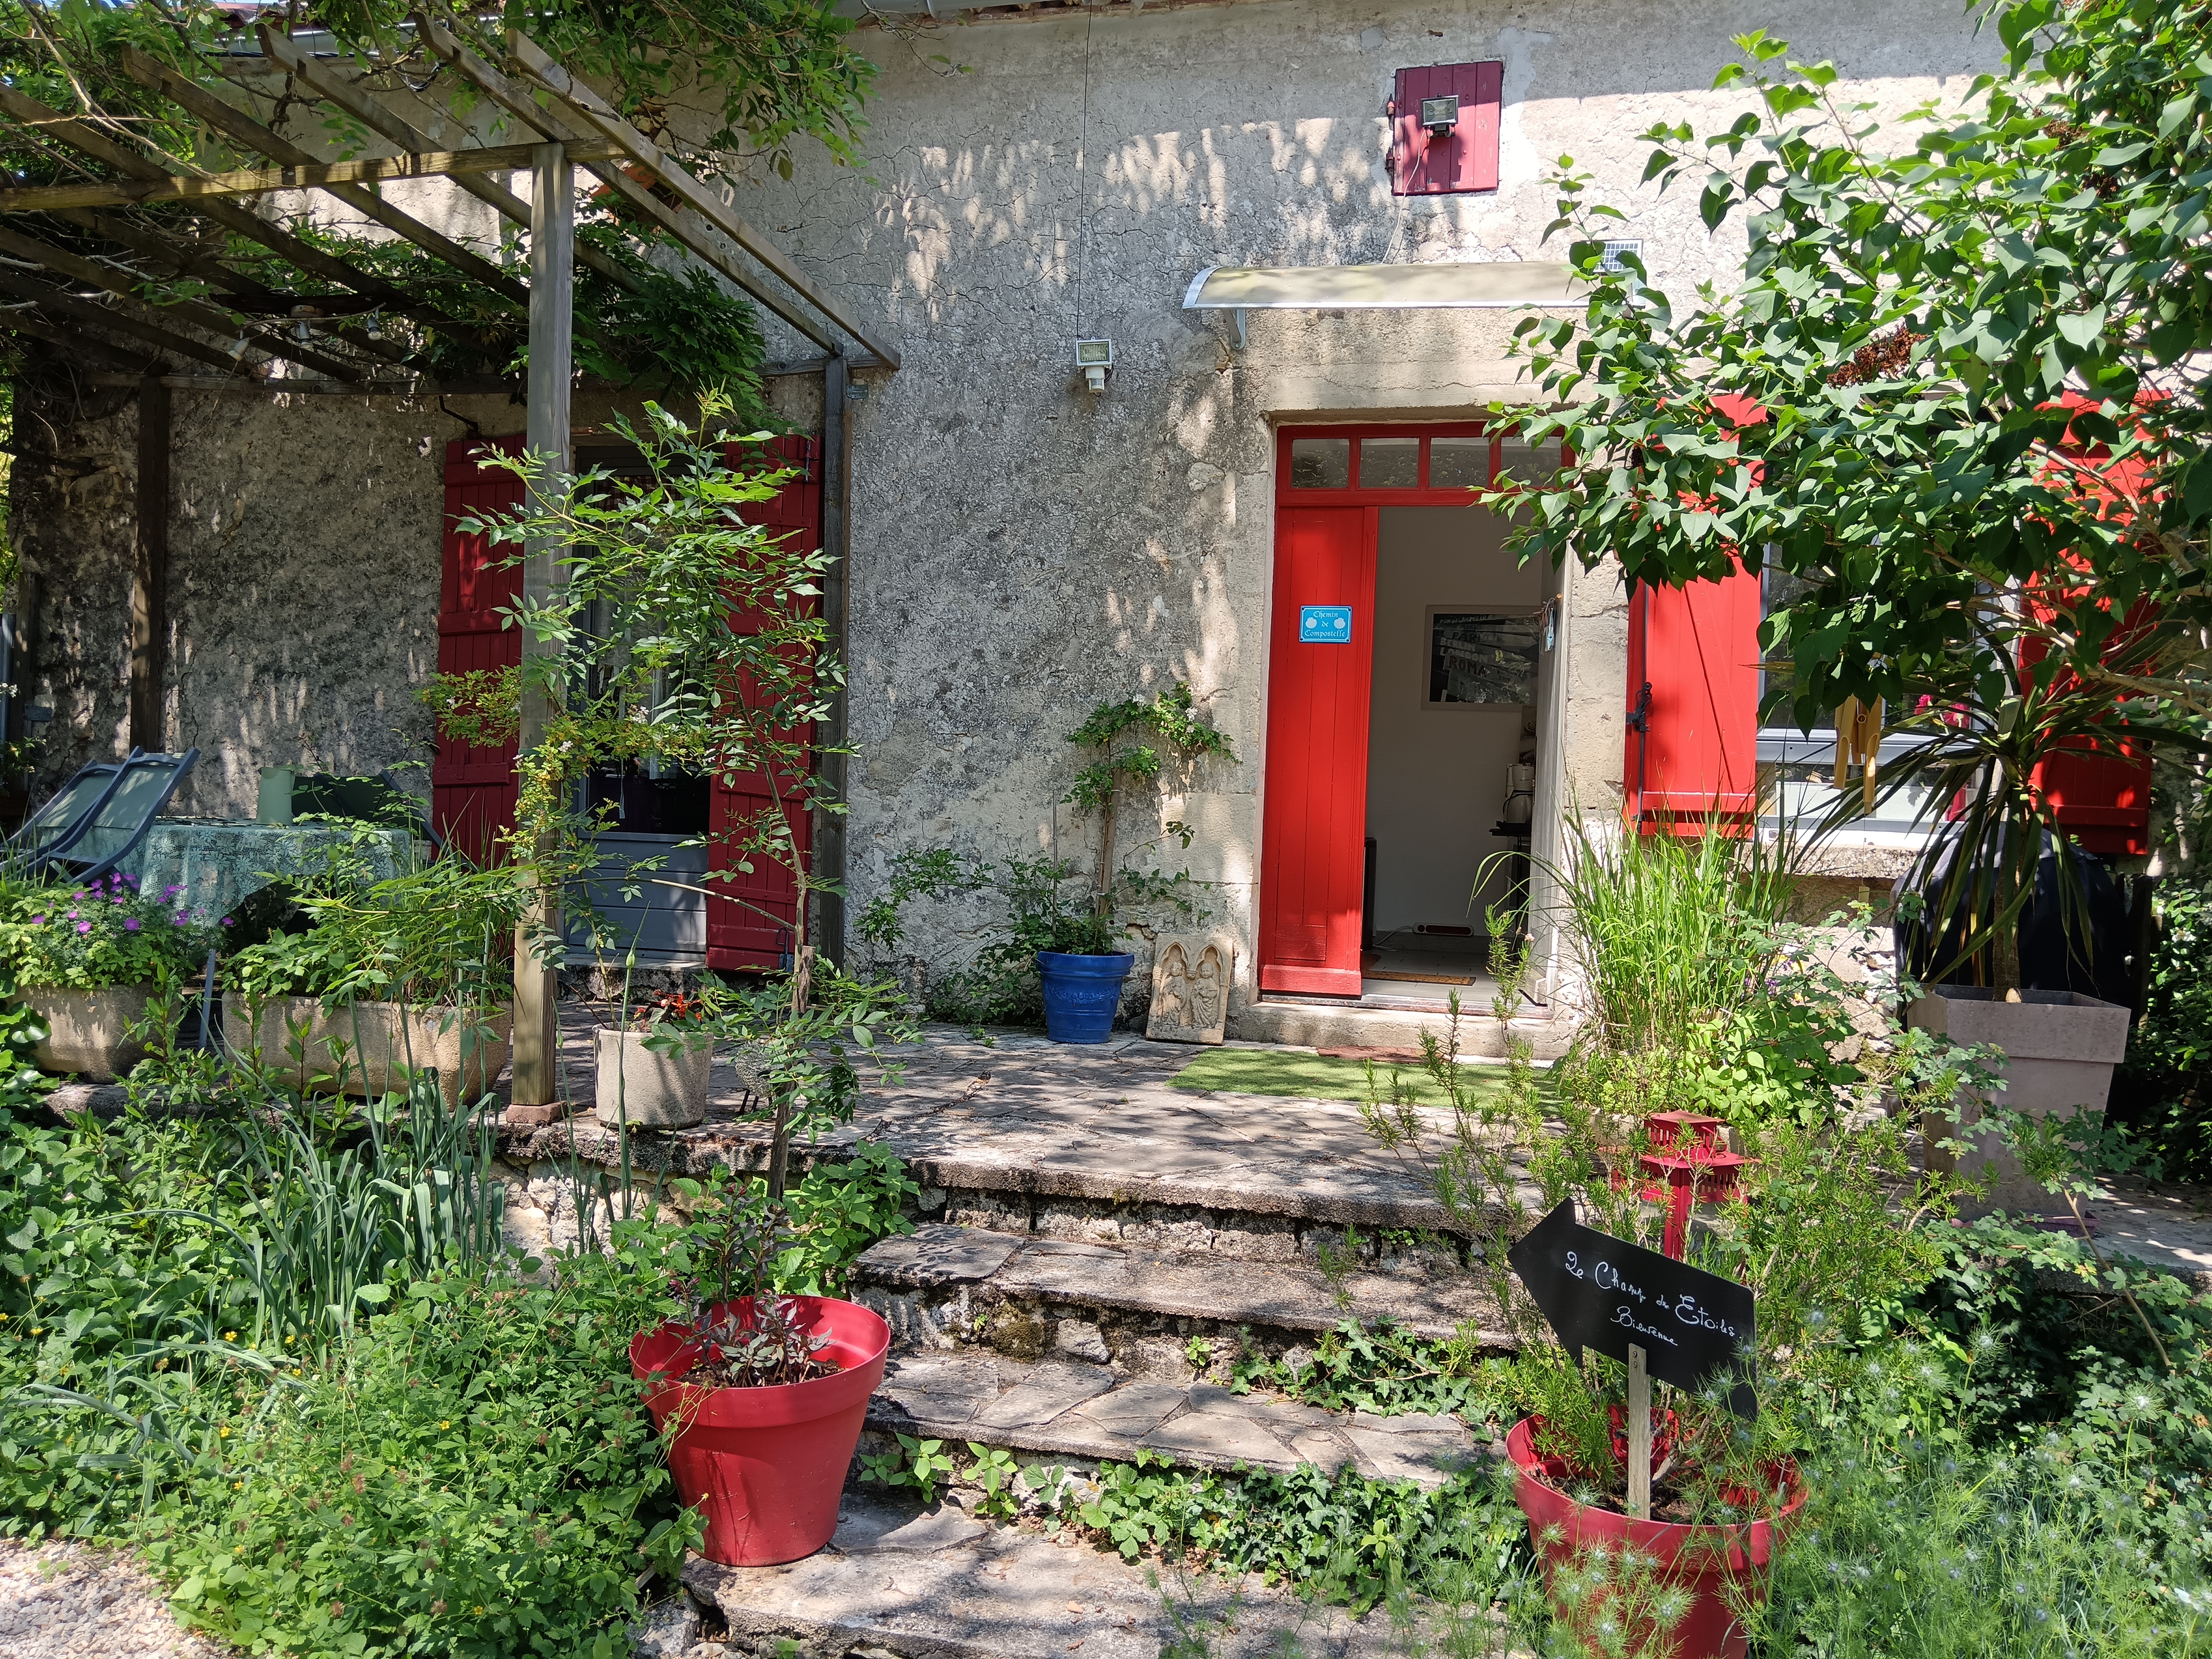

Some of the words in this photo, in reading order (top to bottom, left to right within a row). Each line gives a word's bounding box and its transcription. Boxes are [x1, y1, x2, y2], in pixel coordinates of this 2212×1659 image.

[1313, 610, 1338, 619] Chemin
[1305, 629, 1345, 638] Compostelle
[1440, 637, 1475, 652] BERLIN
[1449, 655, 1487, 678] ROMA
[1565, 1251, 1584, 1279] Le
[1675, 1294, 1735, 1337] Etoiles
[1610, 1306, 1678, 1346] Bienvenue
